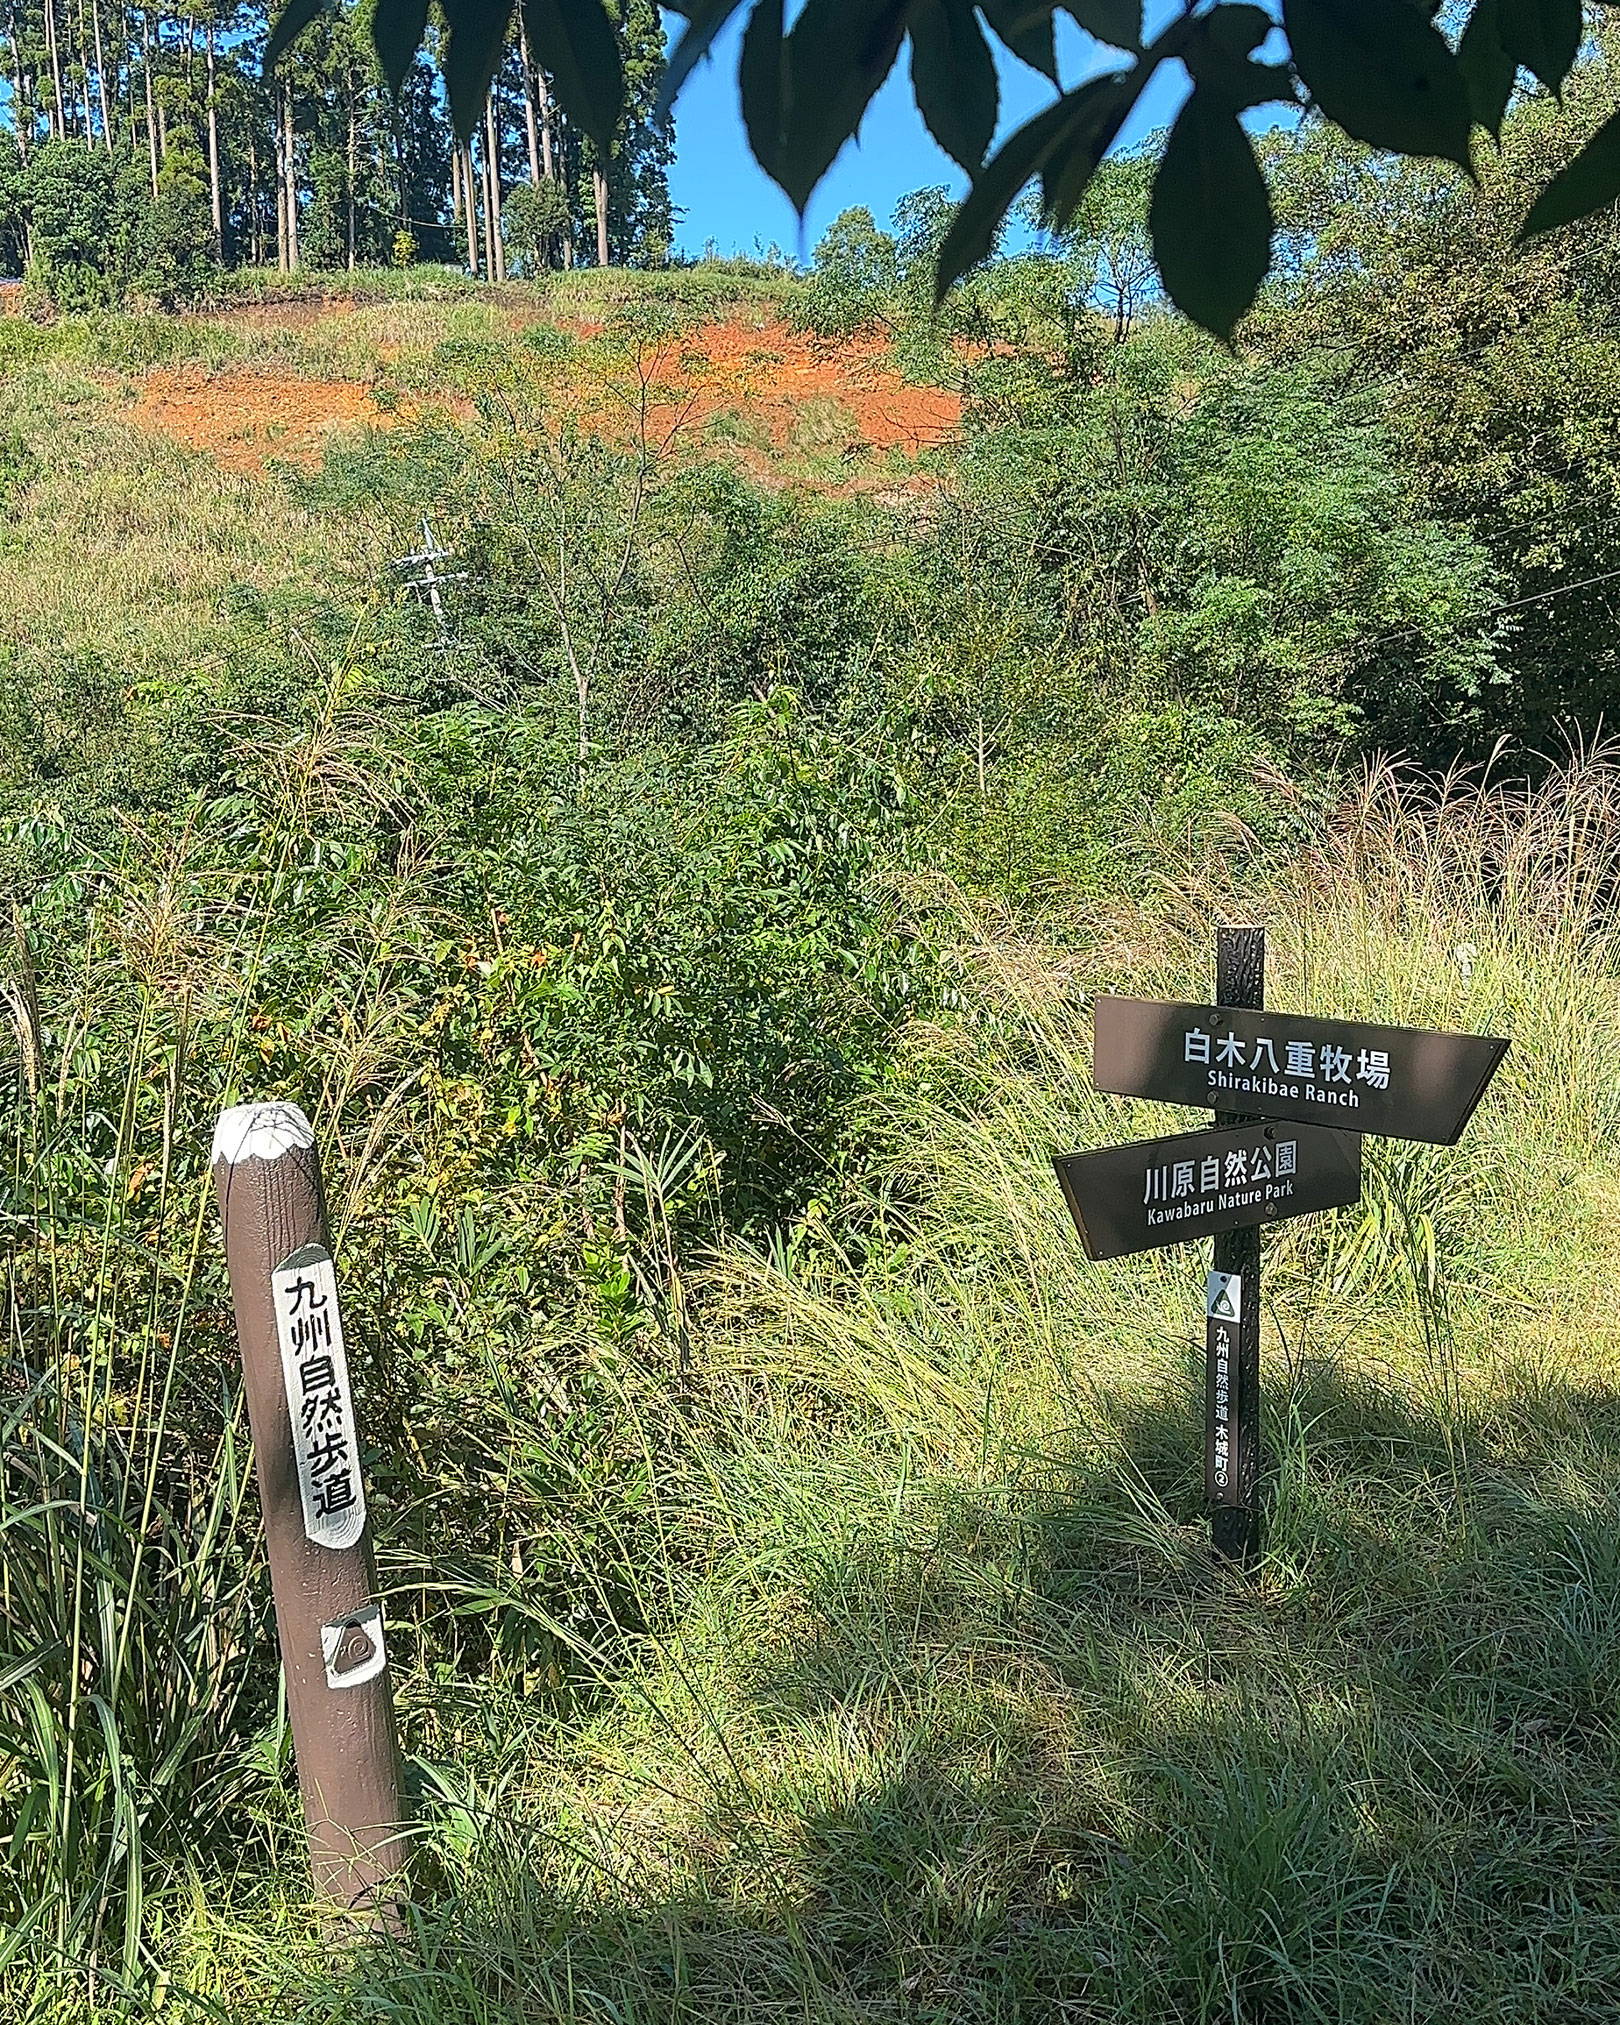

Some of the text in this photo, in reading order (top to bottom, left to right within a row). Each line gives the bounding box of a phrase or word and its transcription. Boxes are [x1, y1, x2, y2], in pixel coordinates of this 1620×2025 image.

[1184, 1027, 1391, 1090] 白木八重牧場
[1207, 1070, 1360, 1108] Shirakibae Ranch
[1143, 1140, 1297, 1205] 川原自然公園
[1147, 1180, 1294, 1226] Kawabaru Nature Park
[284, 1276, 357, 1519] 九州自然歩道
[1215, 1325, 1230, 1422] 九州自然歩道
